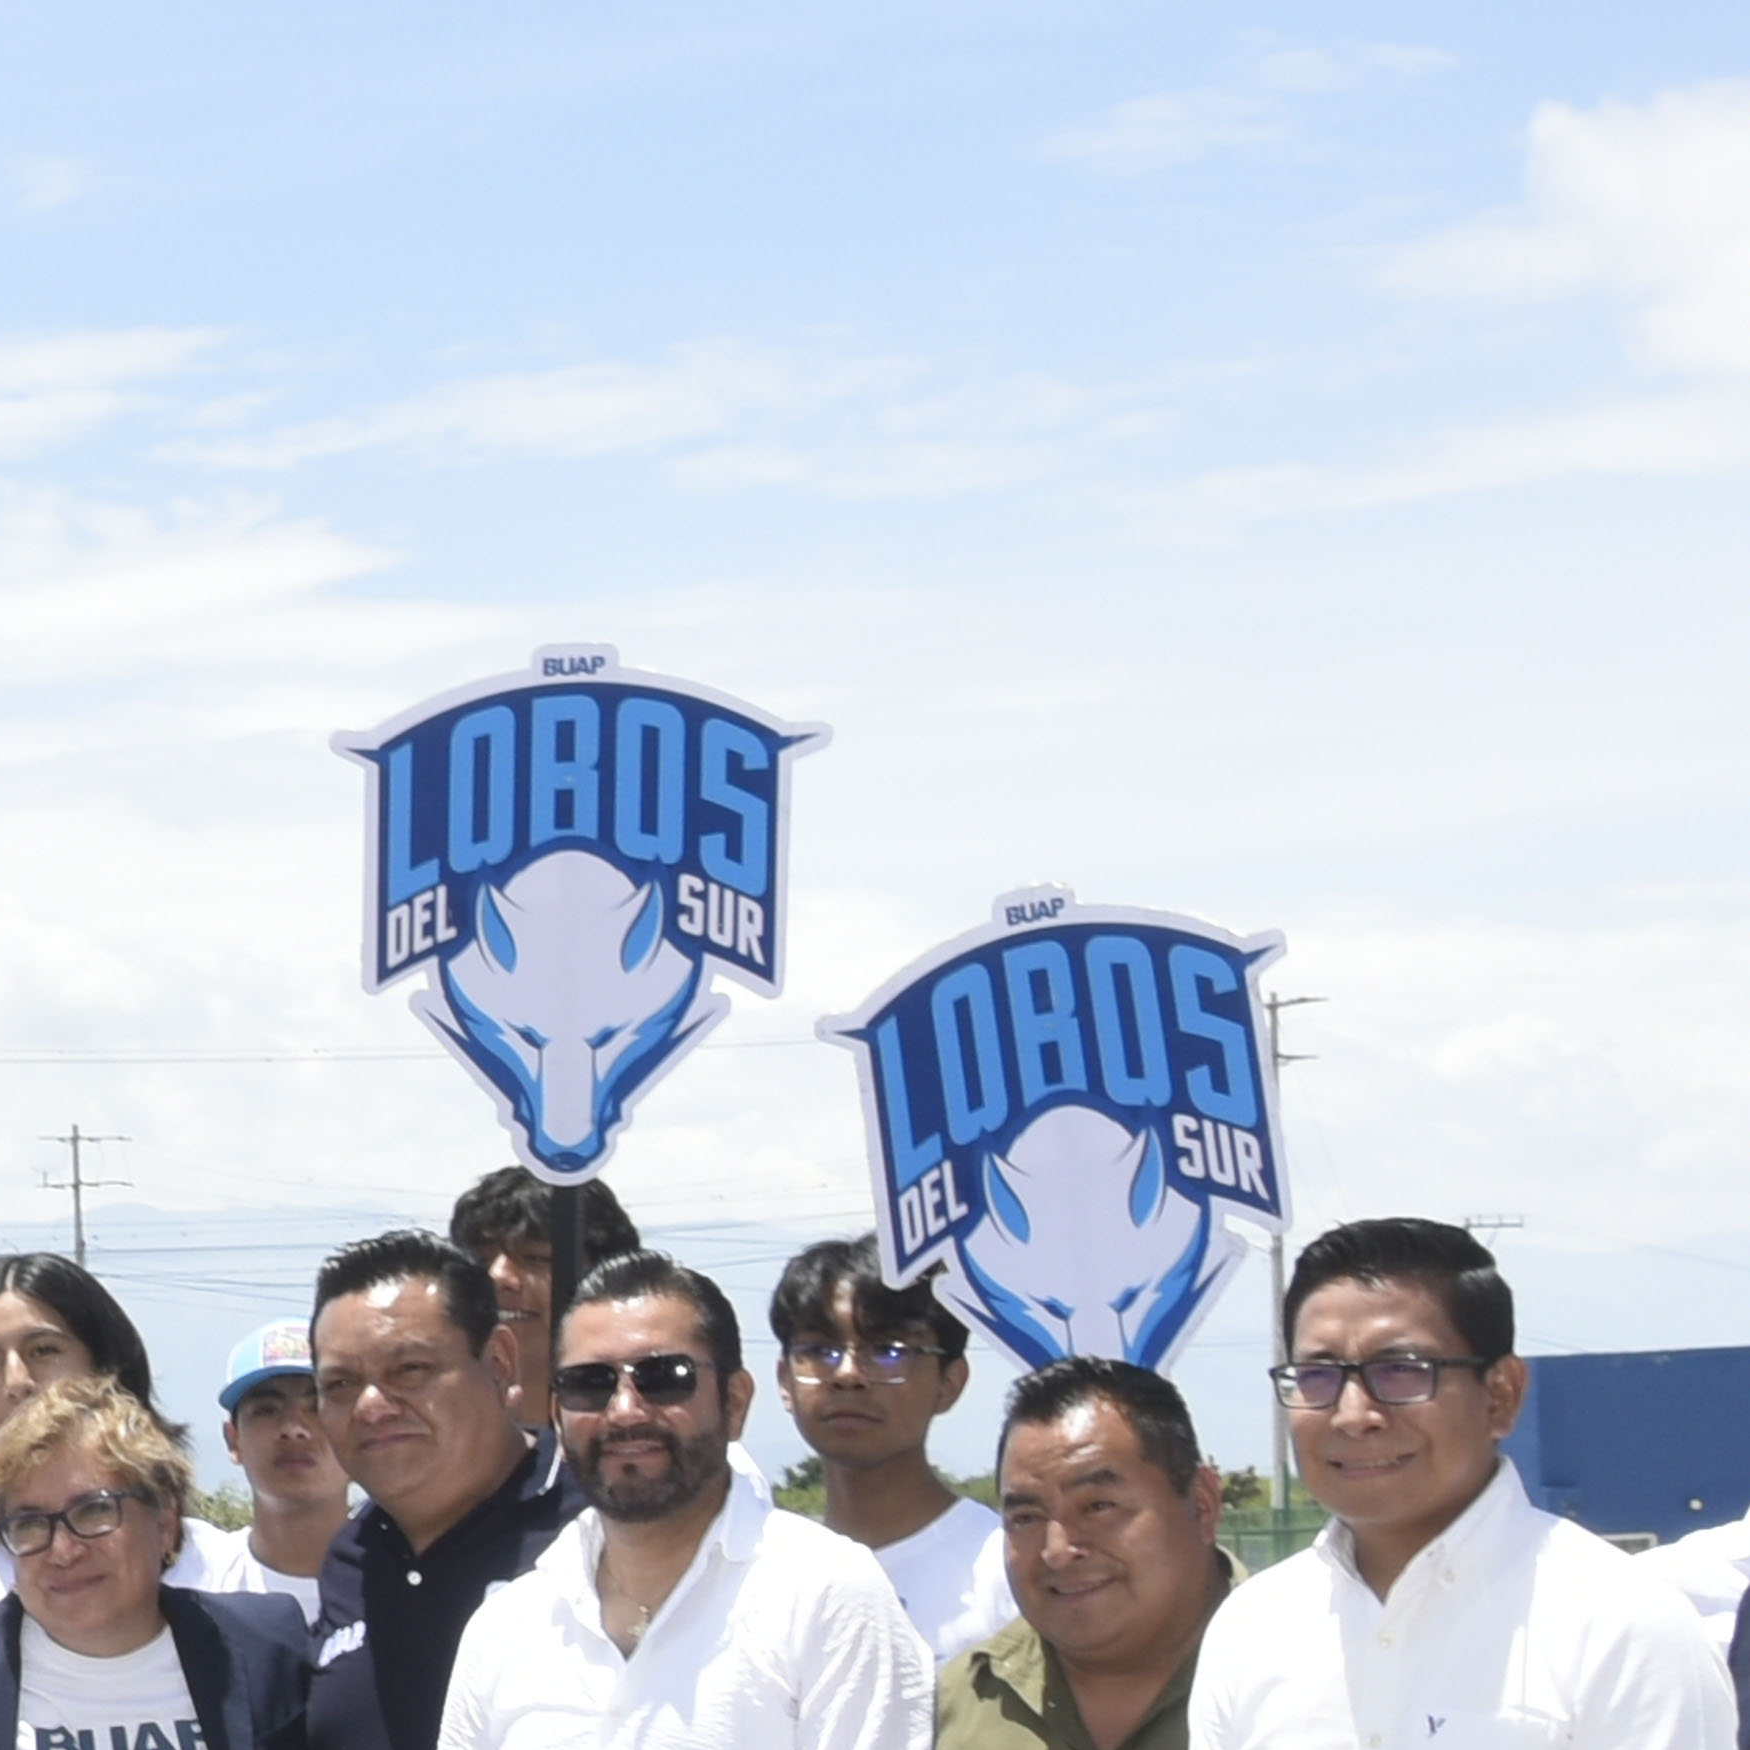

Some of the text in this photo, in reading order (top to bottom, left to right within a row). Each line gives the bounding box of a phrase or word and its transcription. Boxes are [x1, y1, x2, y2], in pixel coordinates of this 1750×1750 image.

[543, 656, 604, 677] BUAP
[387, 694, 769, 906] LOBOS
[387, 884, 457, 970] DEL
[677, 873, 766, 967] SUR
[1005, 898, 1065, 926] BUAP
[877, 935, 1258, 1191] LOBOS
[1171, 1113, 1269, 1200] SUR
[898, 1159, 969, 1257] DEL
